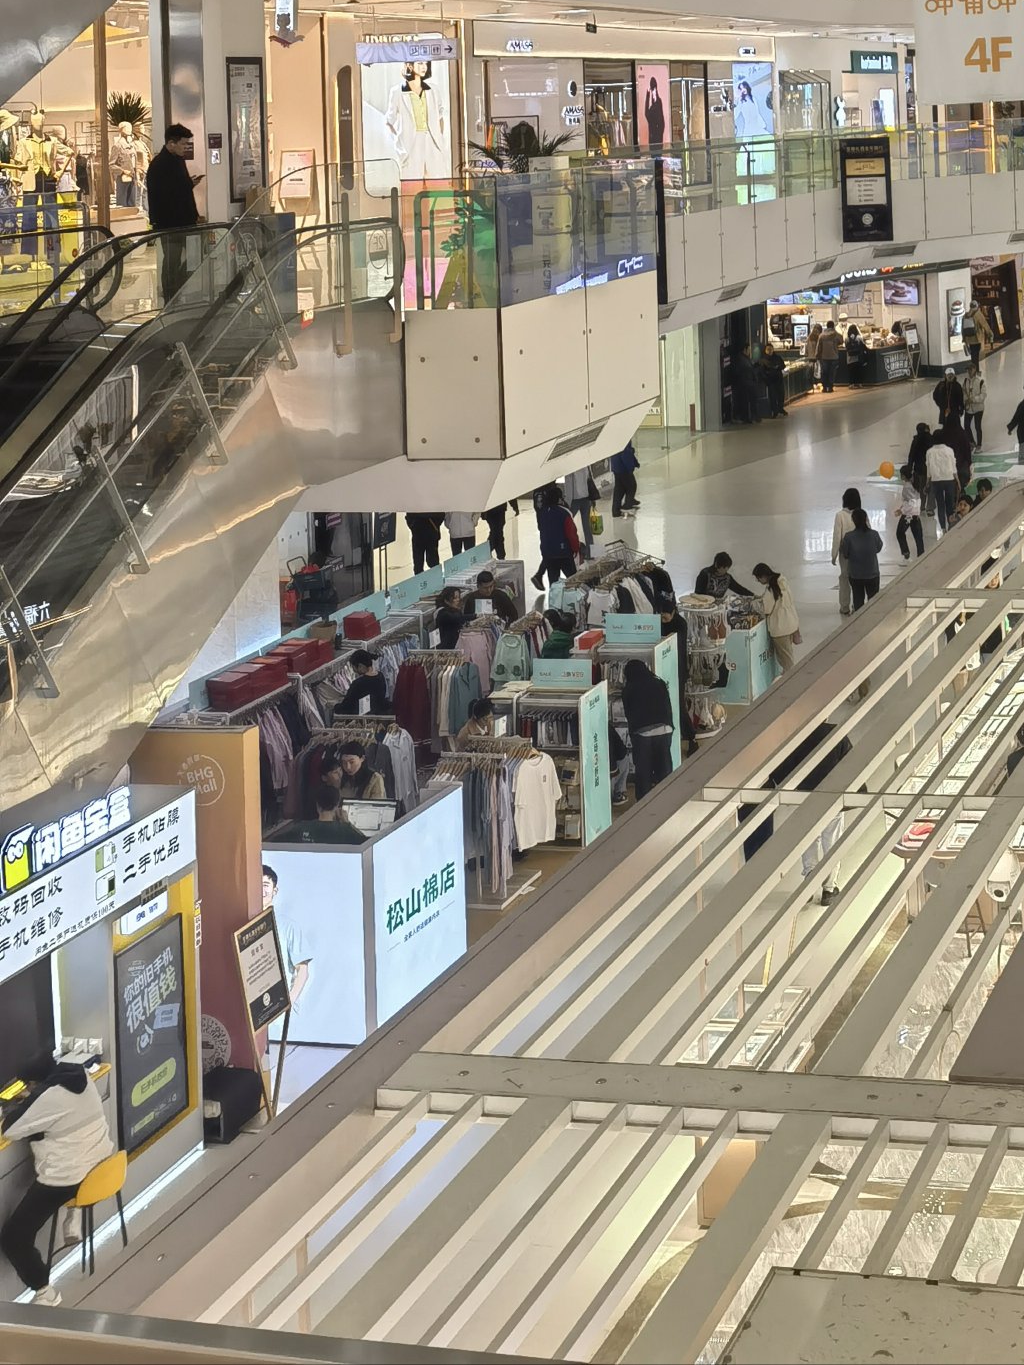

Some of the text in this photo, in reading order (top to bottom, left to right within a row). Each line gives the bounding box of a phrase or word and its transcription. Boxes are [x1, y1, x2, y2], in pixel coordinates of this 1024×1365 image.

[964, 37, 1012, 73] 4F
[187, 766, 214, 783] BHG
[122, 807, 180, 854] 手机贴膜
[122, 835, 180, 883] 二手优品
[386, 861, 455, 935] 松山棉店
[124, 946, 174, 1002] 你的旧手机
[126, 967, 178, 1034] 很值钱
